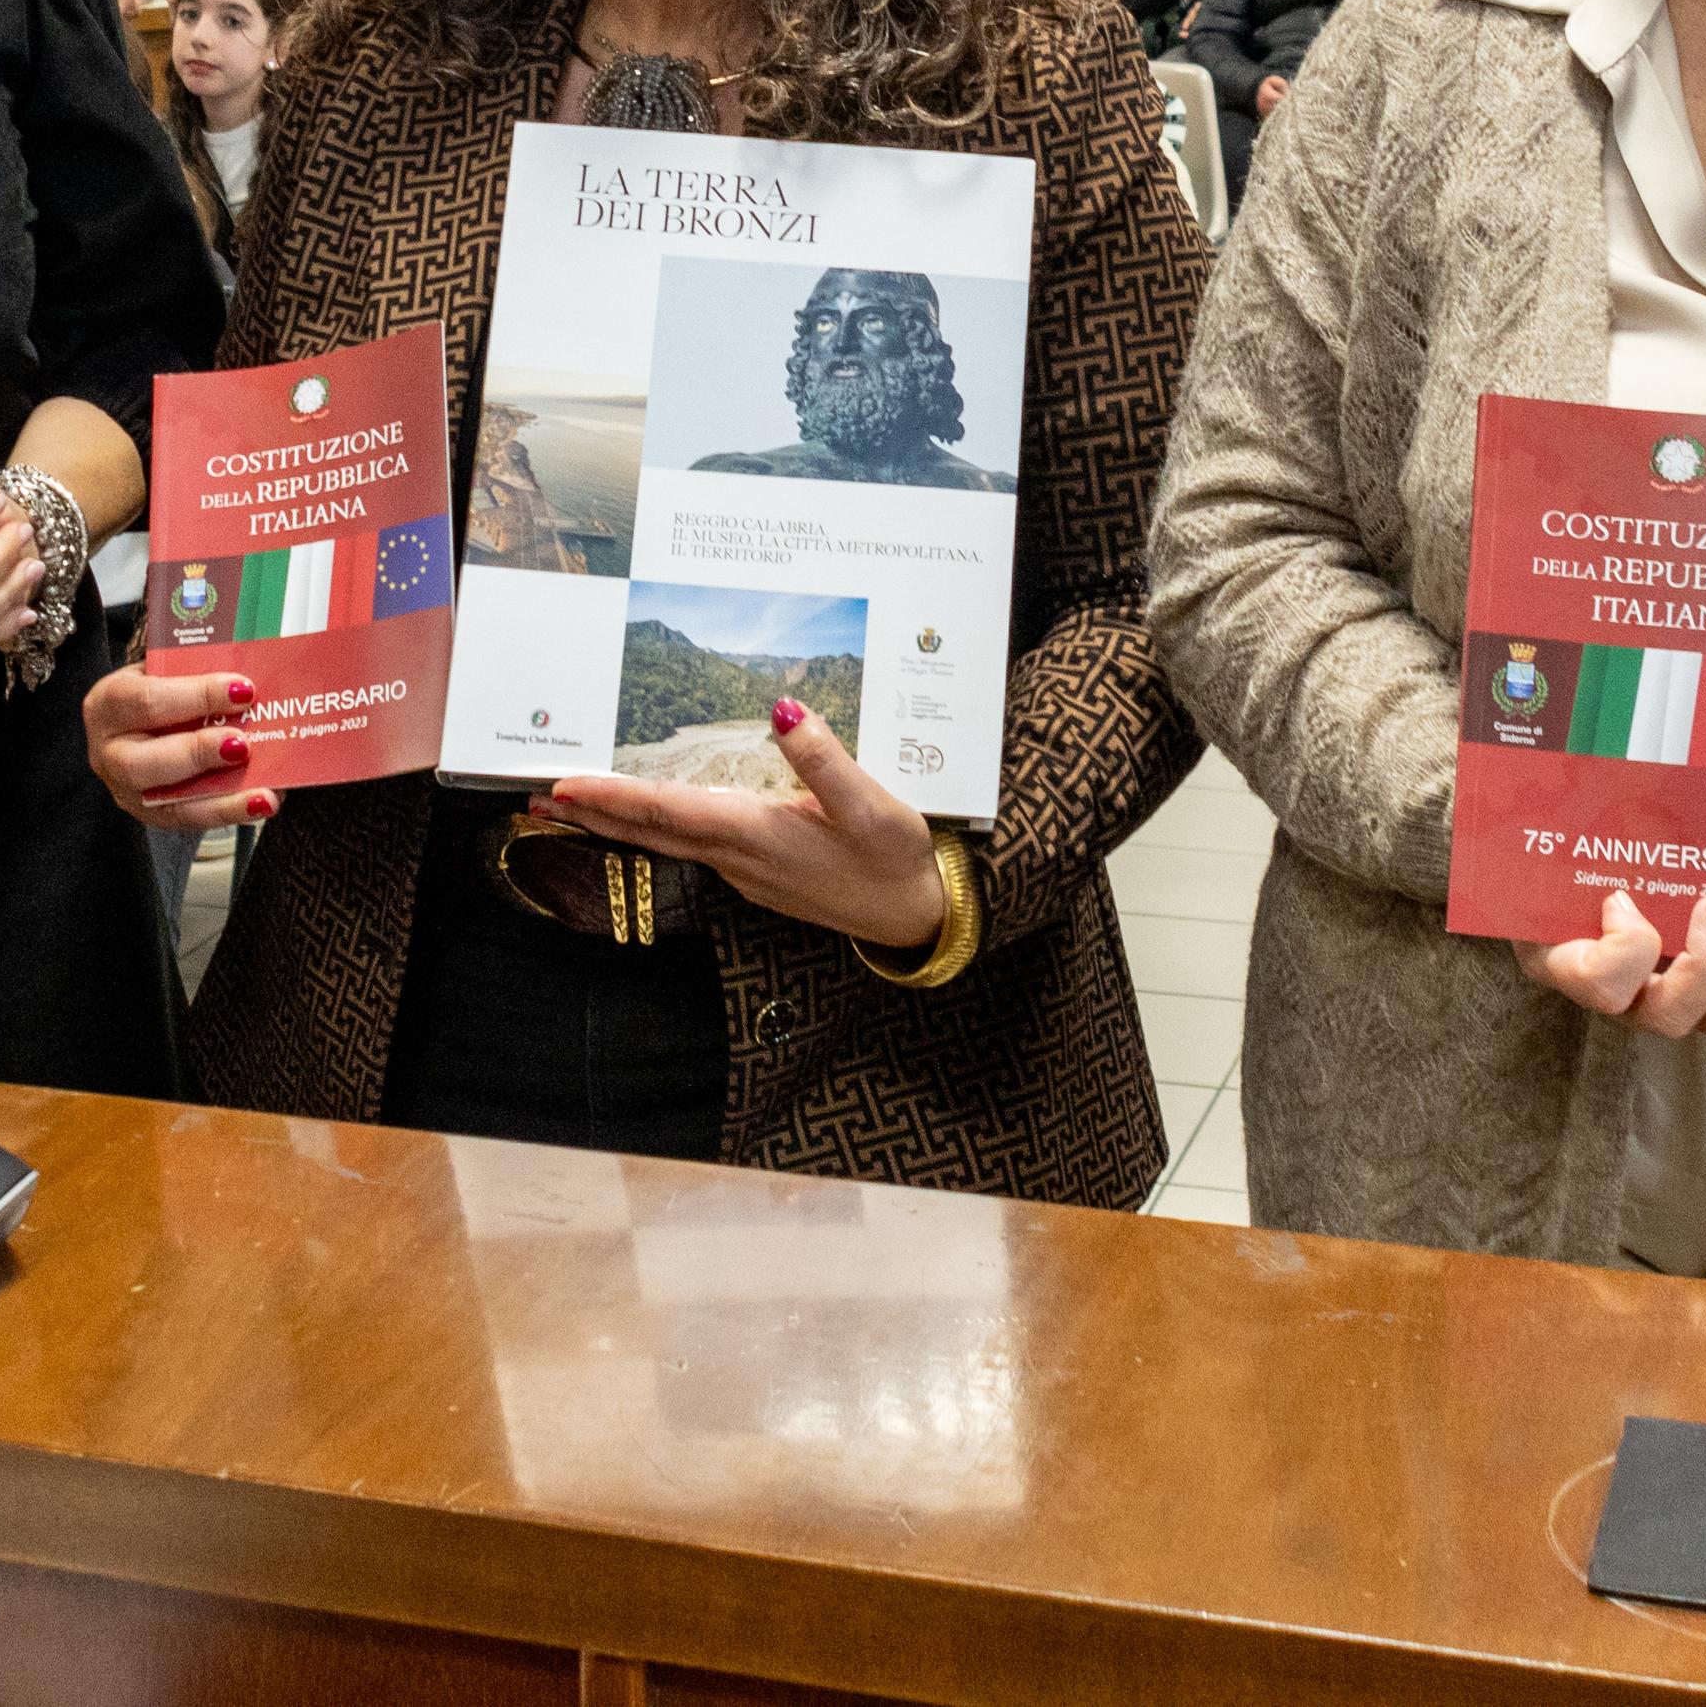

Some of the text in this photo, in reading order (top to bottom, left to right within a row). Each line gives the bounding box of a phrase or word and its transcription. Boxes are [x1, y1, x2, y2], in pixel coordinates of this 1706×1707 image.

[578, 163, 789, 207] LA TERRA
[573, 197, 820, 244] DEI BRONZI
[206, 420, 404, 477] COSTITUZIONE
[200, 452, 410, 510] DELLA REPUBBLICA
[249, 495, 367, 536] ITALIANA
[673, 511, 738, 529] REGGIO
[672, 527, 688, 541] IL
[759, 534, 780, 550] LA
[670, 544, 793, 565] IL TERRITORIO
[1532, 556, 1597, 581] DELLA
[241, 680, 407, 724] ANNIVERSARIO
[243, 715, 368, 743] iderno, 2 giugno 2023
[1493, 720, 1543, 735] Comune di
[1499, 732, 1536, 746] Siderno
[1573, 869, 1630, 891] Siderno,
[1634, 876, 1645, 891] 2
[1646, 878, 1697, 897] giugno
